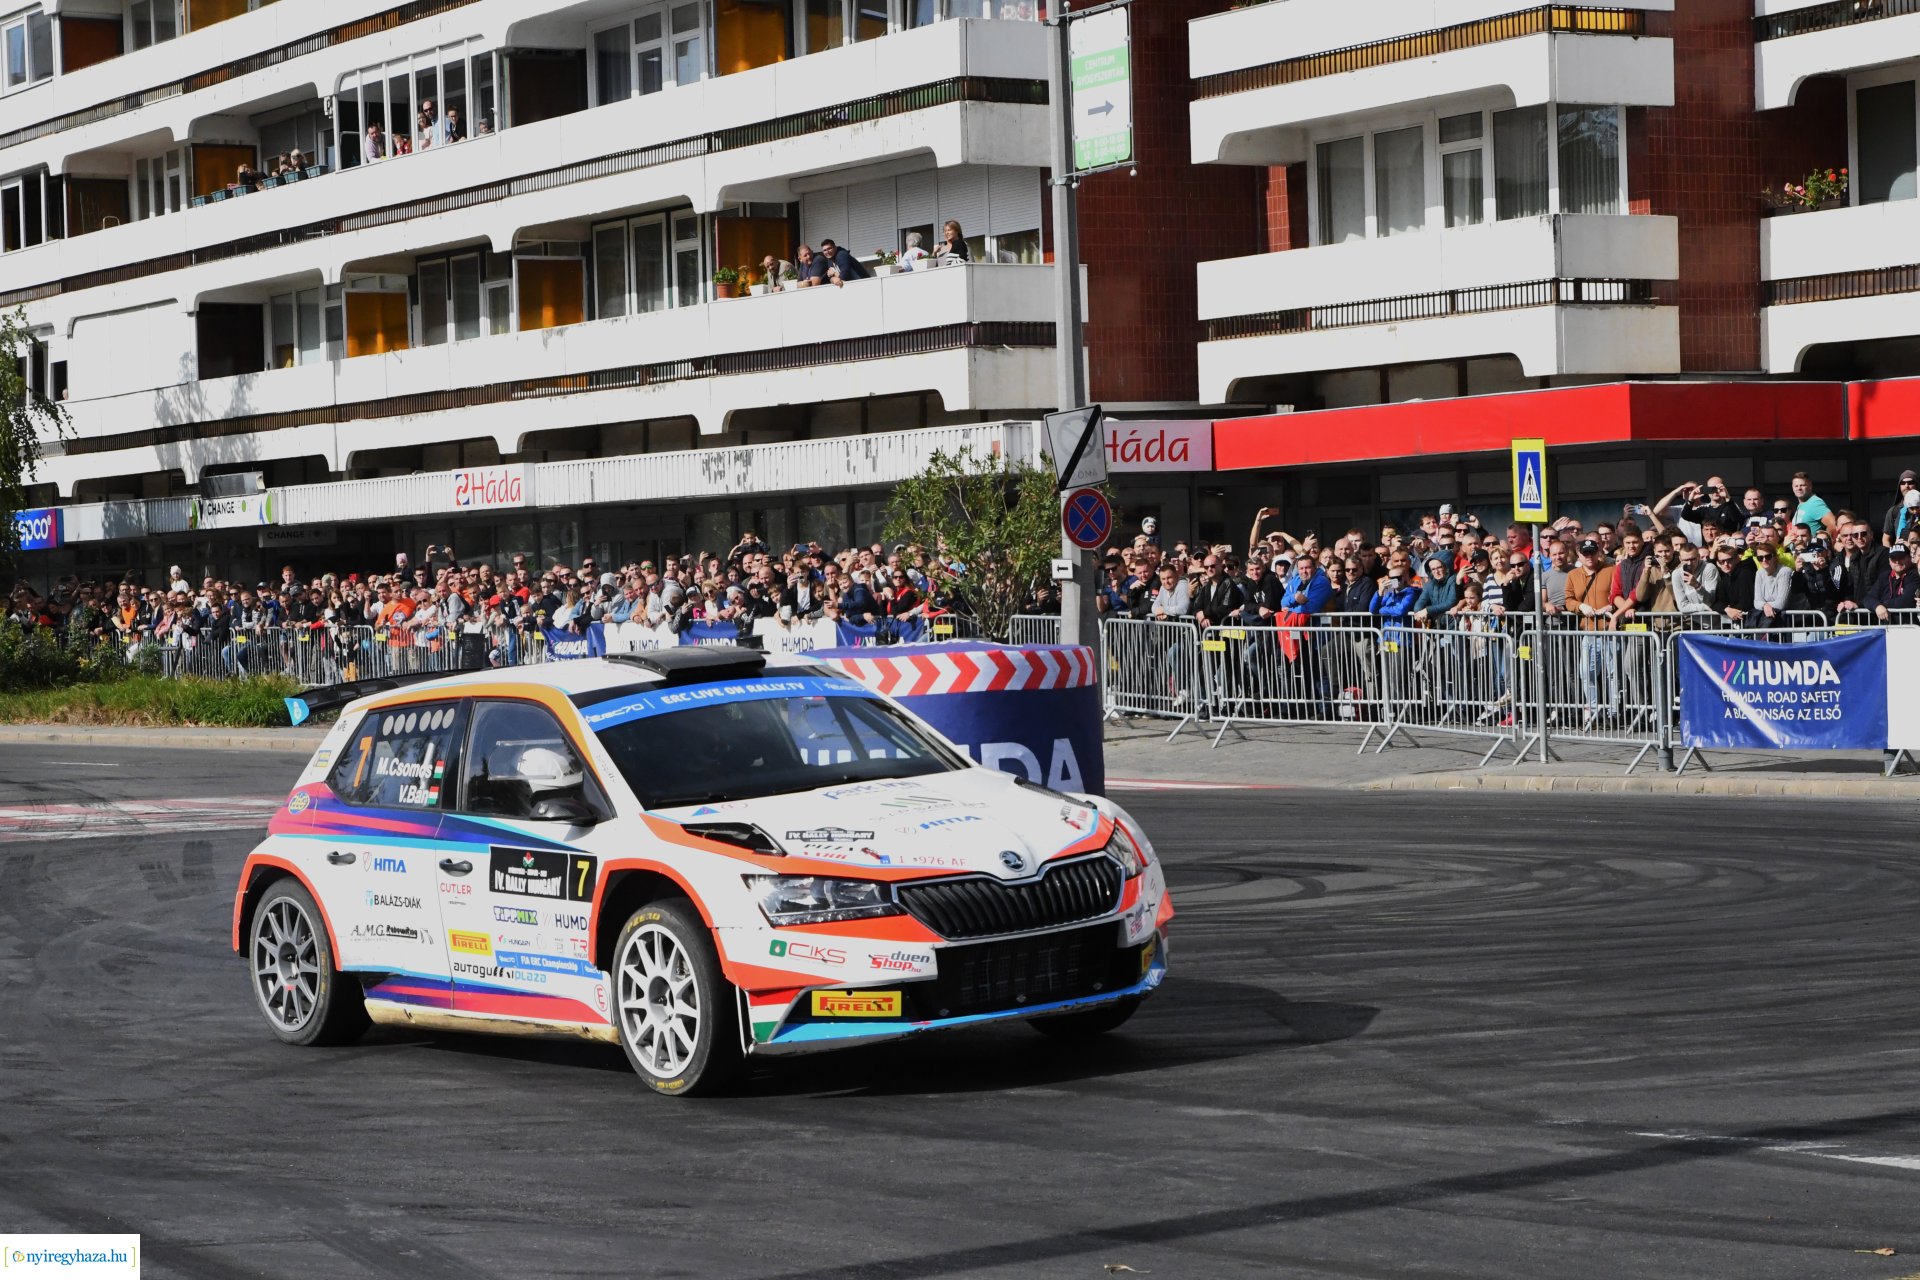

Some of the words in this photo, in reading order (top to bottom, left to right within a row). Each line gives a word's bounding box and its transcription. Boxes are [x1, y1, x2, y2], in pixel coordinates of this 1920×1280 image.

[472, 470, 521, 504] Háda
[207, 501, 235, 516] CHANGE
[267, 529, 305, 540] CHANGE
[554, 639, 589, 655] HUMDA
[782, 637, 814, 652] HUMDA
[1747, 660, 1841, 686] HUMDA
[660, 692, 691, 705] ERC
[691, 688, 724, 700] LIVE
[724, 685, 745, 695] ON
[745, 682, 805, 693] RALLY.TV
[1768, 691, 1798, 704] ROAD
[1801, 690, 1841, 704] SAFETY
[1724, 708, 1732, 719] A
[1734, 705, 1794, 721] BIZONSÁG
[1797, 708, 1811, 721] AZ
[1814, 704, 1842, 720] ELSŐ
[505, 874, 527, 893] RALLY
[527, 876, 562, 897] HUNGARY
[577, 860, 590, 897] 7
[440, 882, 472, 895] CUTLER
[554, 913, 588, 931] HUMD
[451, 933, 488, 951] PIRELLI
[788, 942, 848, 964] CIKS
[890, 951, 931, 963] duen
[819, 996, 894, 1012] PIRELLI
